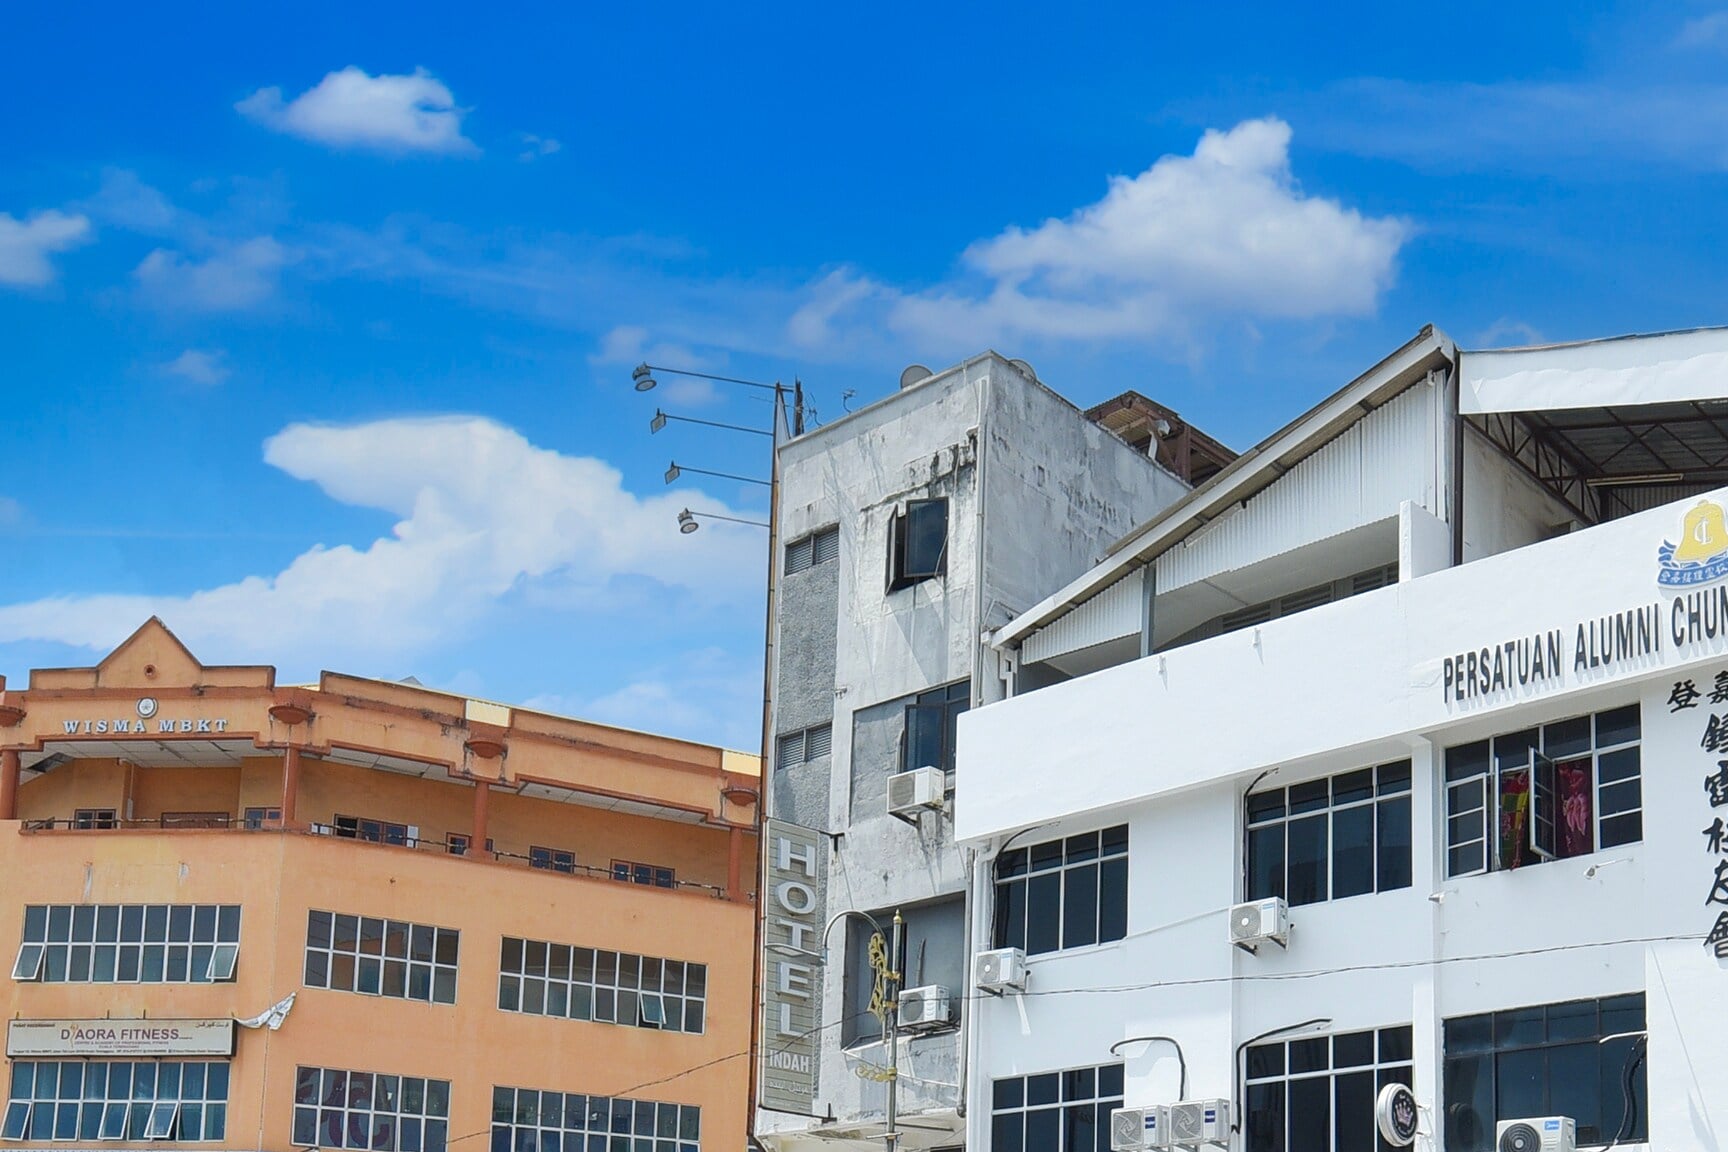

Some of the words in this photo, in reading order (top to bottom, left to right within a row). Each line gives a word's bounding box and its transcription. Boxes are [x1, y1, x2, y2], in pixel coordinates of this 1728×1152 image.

[1443, 629, 1560, 704] PERSATUAN
[1574, 603, 1659, 673] ALUMNI
[63, 719, 146, 734] WISMA
[159, 719, 229, 733] MBKT
[777, 836, 815, 1038] HOTEL
[121, 1028, 180, 1040] FITNESS
[769, 1050, 809, 1074] INDAH
